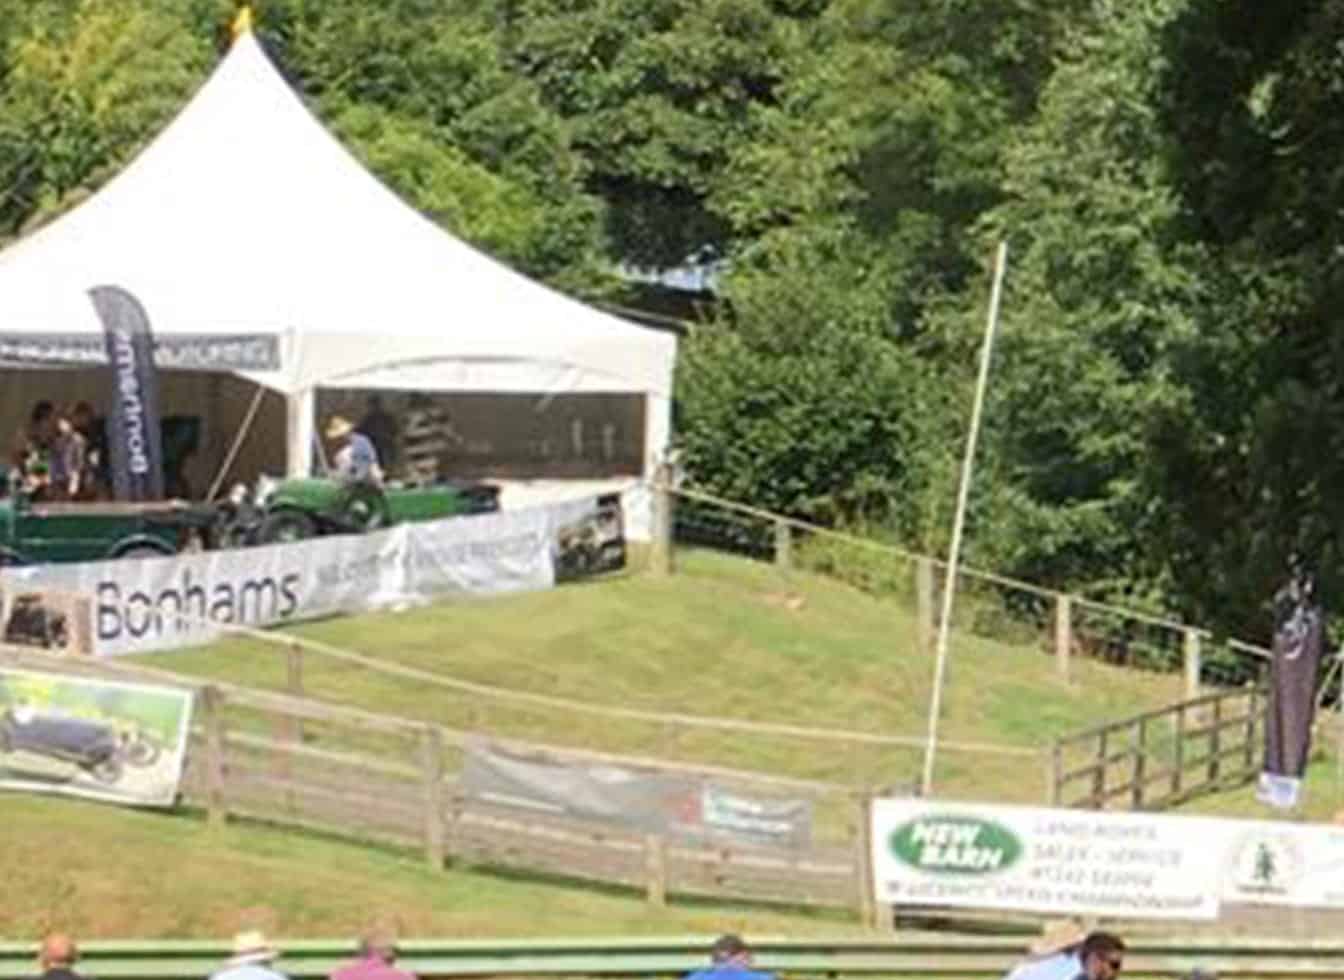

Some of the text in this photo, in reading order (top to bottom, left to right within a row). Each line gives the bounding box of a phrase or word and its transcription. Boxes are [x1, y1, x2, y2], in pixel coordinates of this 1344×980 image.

[96, 570, 300, 640] Bonhams
[910, 822, 983, 849] NEW
[918, 845, 1004, 868] BARN
